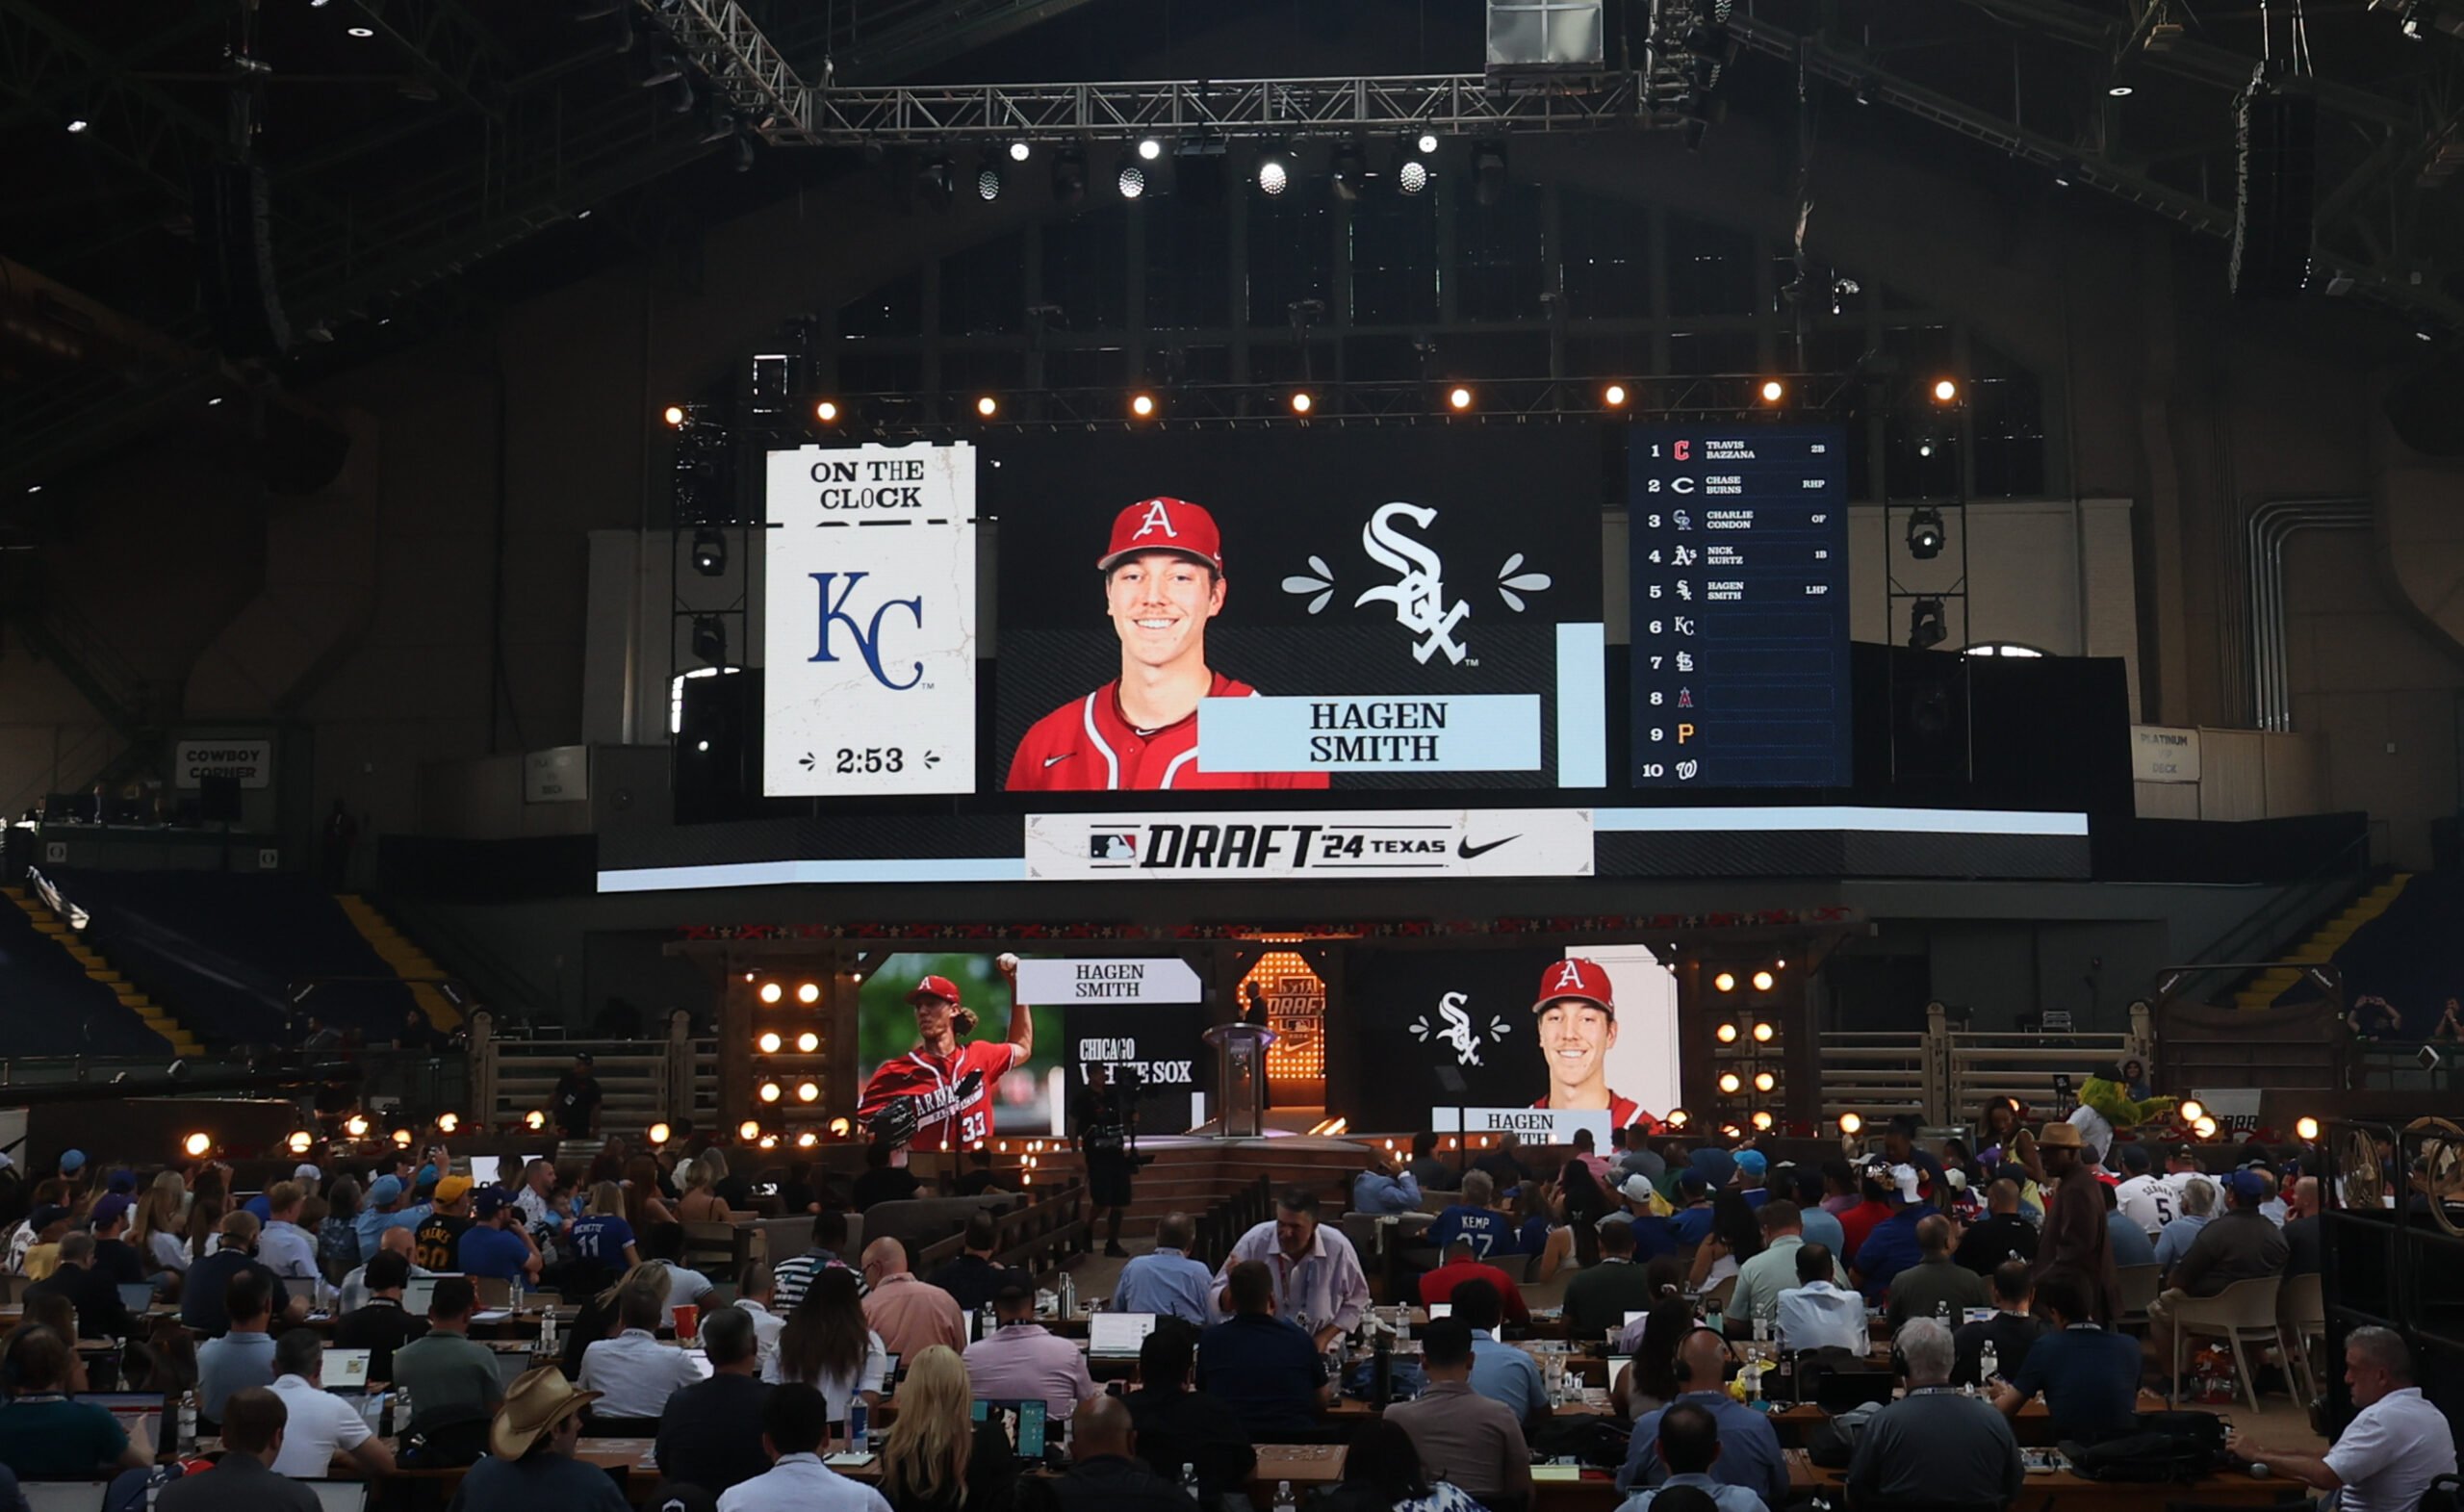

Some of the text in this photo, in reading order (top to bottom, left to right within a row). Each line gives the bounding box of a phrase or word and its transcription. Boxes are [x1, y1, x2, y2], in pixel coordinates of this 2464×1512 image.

[1652, 445, 1660, 457] 1
[1706, 441, 1745, 450] TRAVIS
[1810, 445, 1826, 453] 2B
[1706, 450, 1756, 460] BAZZANA
[810, 460, 925, 482] ON THE
[1648, 479, 1660, 493] 2
[1706, 476, 1741, 485] CHASE
[1803, 480, 1825, 489] RHP
[1706, 486, 1742, 495] BURNS
[820, 487, 923, 509] CLOCK
[1132, 500, 1178, 541] A
[1648, 515, 1661, 527] 3
[1707, 511, 1754, 520] CHARLIE
[1811, 515, 1827, 524] OF
[1707, 521, 1751, 529] CONDON
[1649, 550, 1662, 563] 4
[1707, 547, 1733, 555] NICK
[1814, 551, 1827, 559] 1B
[1707, 556, 1744, 565] KURTZ
[1649, 585, 1662, 599] 5
[1707, 581, 1744, 590] HAGEN
[1806, 586, 1828, 595] LHP
[1707, 592, 1742, 601] SMITH
[808, 571, 924, 691] KC
[1649, 620, 1662, 634] 6
[1650, 656, 1662, 670] 7
[1650, 691, 1663, 705] 8
[1310, 703, 1449, 730] HAGEN
[1650, 728, 1663, 742] 9
[1678, 724, 1695, 745] P
[187, 751, 260, 761] COWBOY
[1310, 735, 1440, 763] SMITH
[836, 748, 904, 773] 2:53
[191, 767, 256, 778] CORNER
[1642, 764, 1664, 778] 10
[1140, 825, 1323, 868] DRAFT
[1371, 840, 1447, 854] TEXAS
[1075, 964, 1145, 979] HAGEN
[1554, 961, 1585, 991] A
[1075, 982, 1140, 998] SMITH
[1079, 1038, 1136, 1061] CHICAGO
[1152, 1061, 1193, 1084] SOX
[962, 1111, 987, 1142] 33
[1488, 1114, 1554, 1130] HAGEN
[1516, 1133, 1550, 1145] ITH
[2156, 1198, 2172, 1226] 5
[1461, 1216, 1491, 1230] KEMP
[578, 1235, 600, 1257] 11
